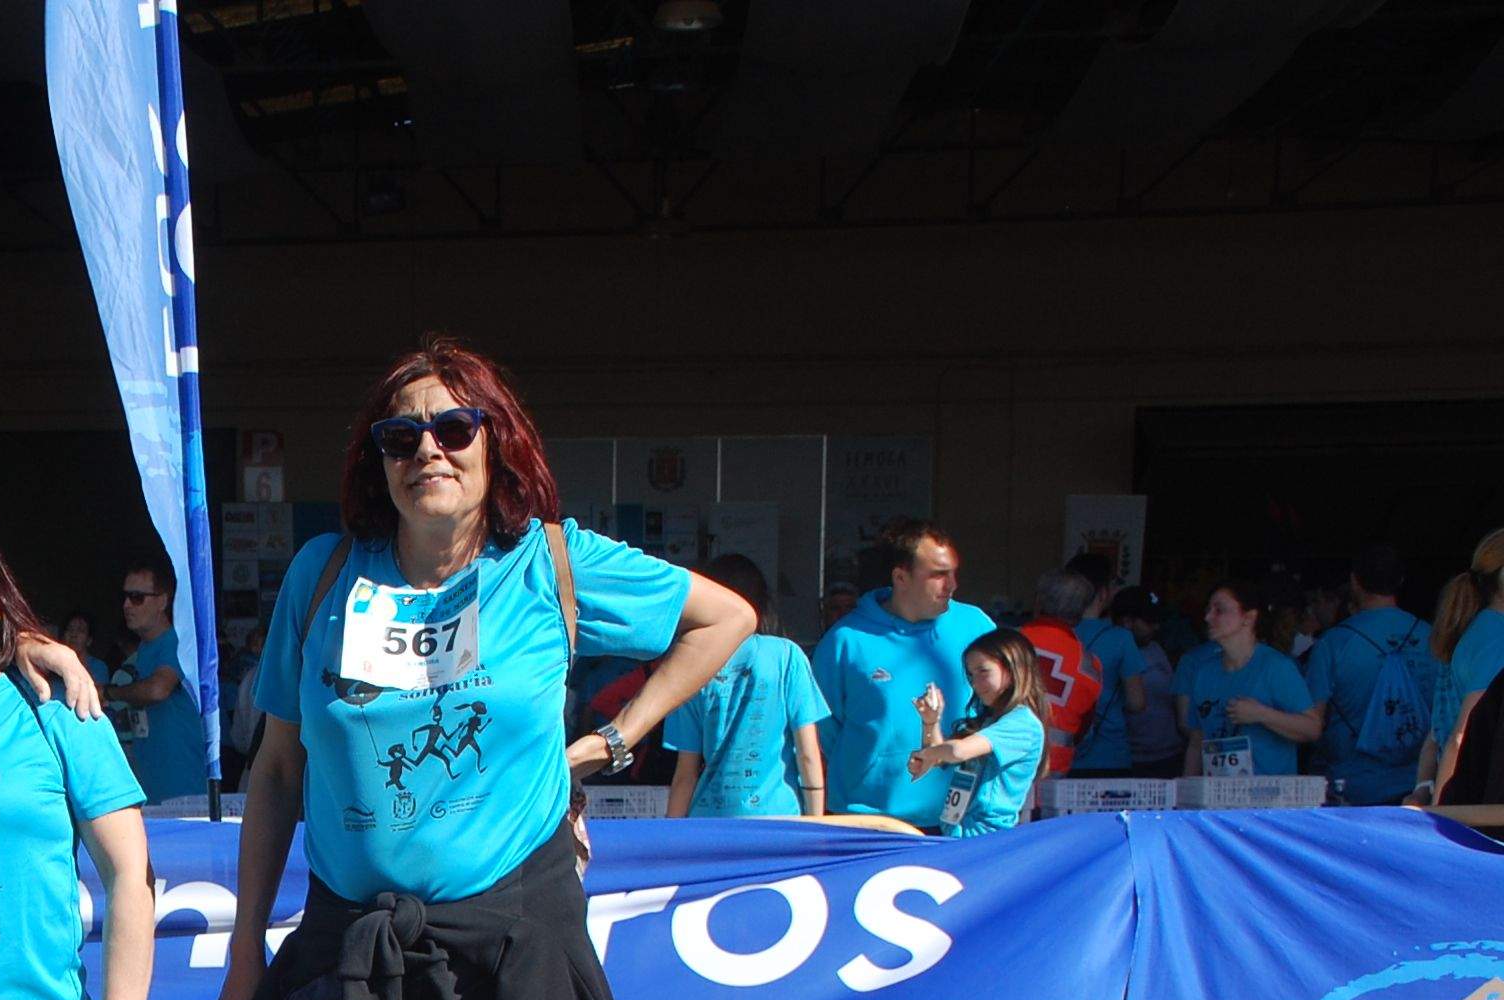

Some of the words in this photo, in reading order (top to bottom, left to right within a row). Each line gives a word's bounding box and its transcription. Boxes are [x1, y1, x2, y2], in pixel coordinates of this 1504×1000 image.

[253, 432, 278, 463] P
[383, 617, 462, 658] 567
[1212, 753, 1239, 768] 476
